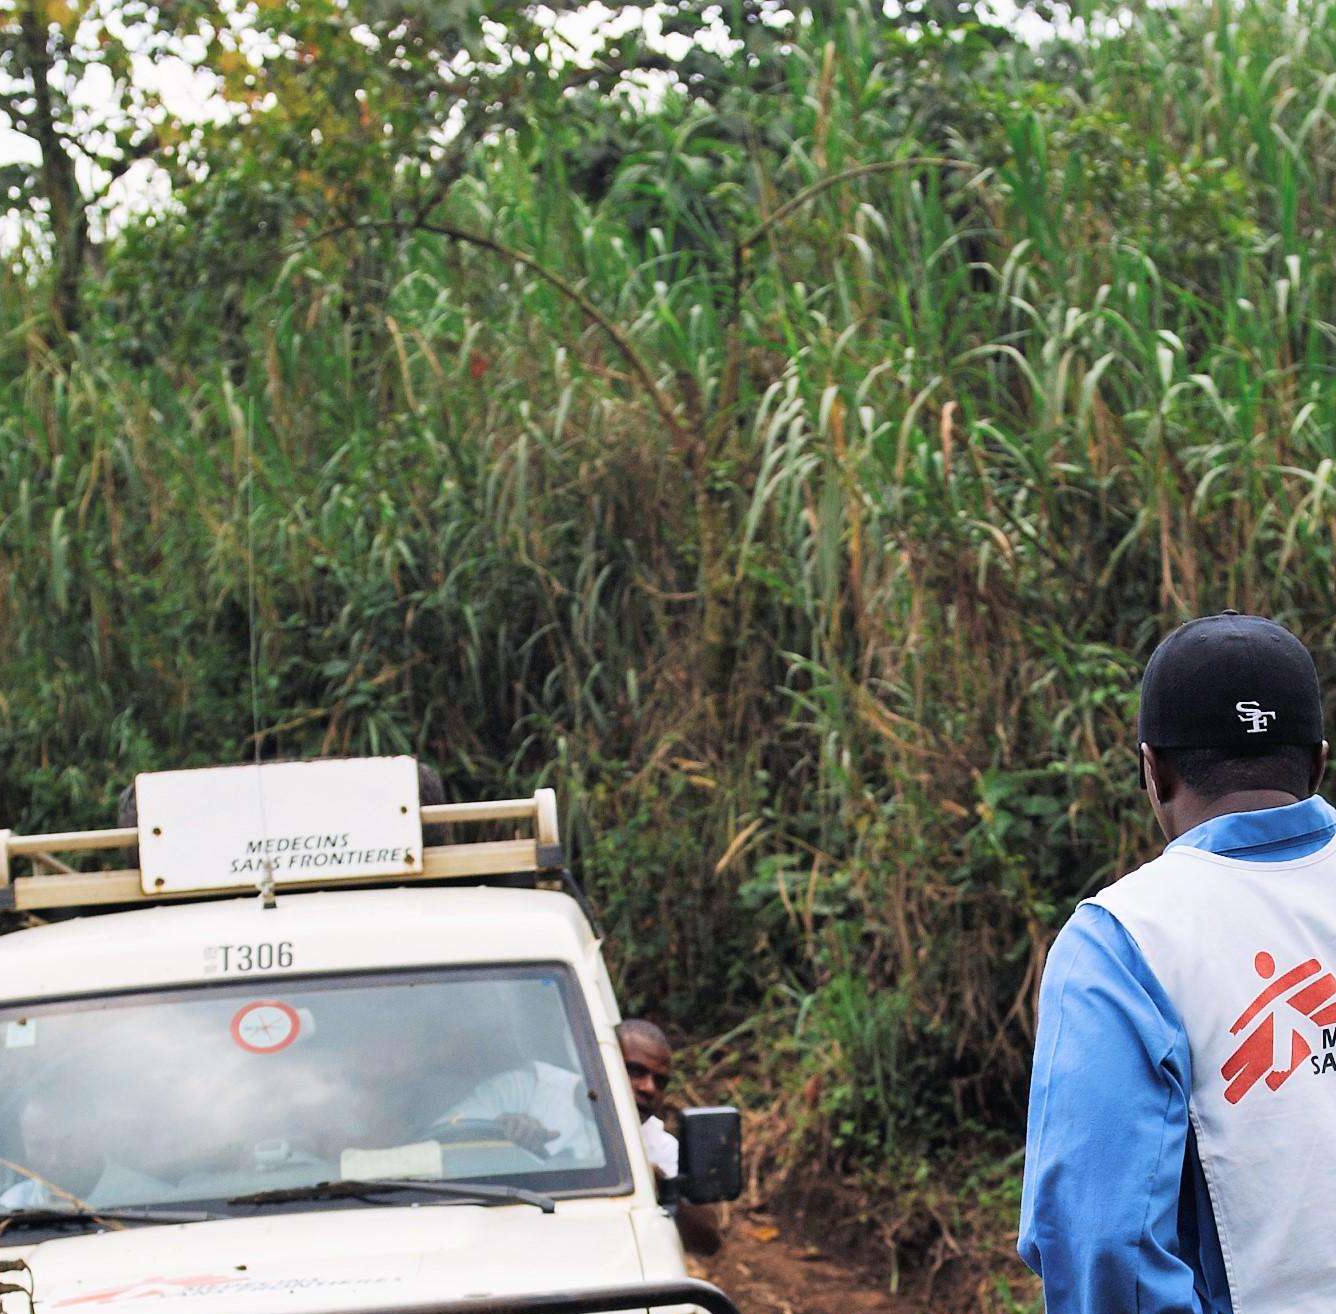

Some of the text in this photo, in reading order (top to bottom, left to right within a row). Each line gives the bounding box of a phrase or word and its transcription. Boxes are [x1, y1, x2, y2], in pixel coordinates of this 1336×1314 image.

[245, 832, 352, 854] MEDECINS
[230, 847, 414, 874] SANS FRONTIERES
[218, 941, 294, 972] T306
